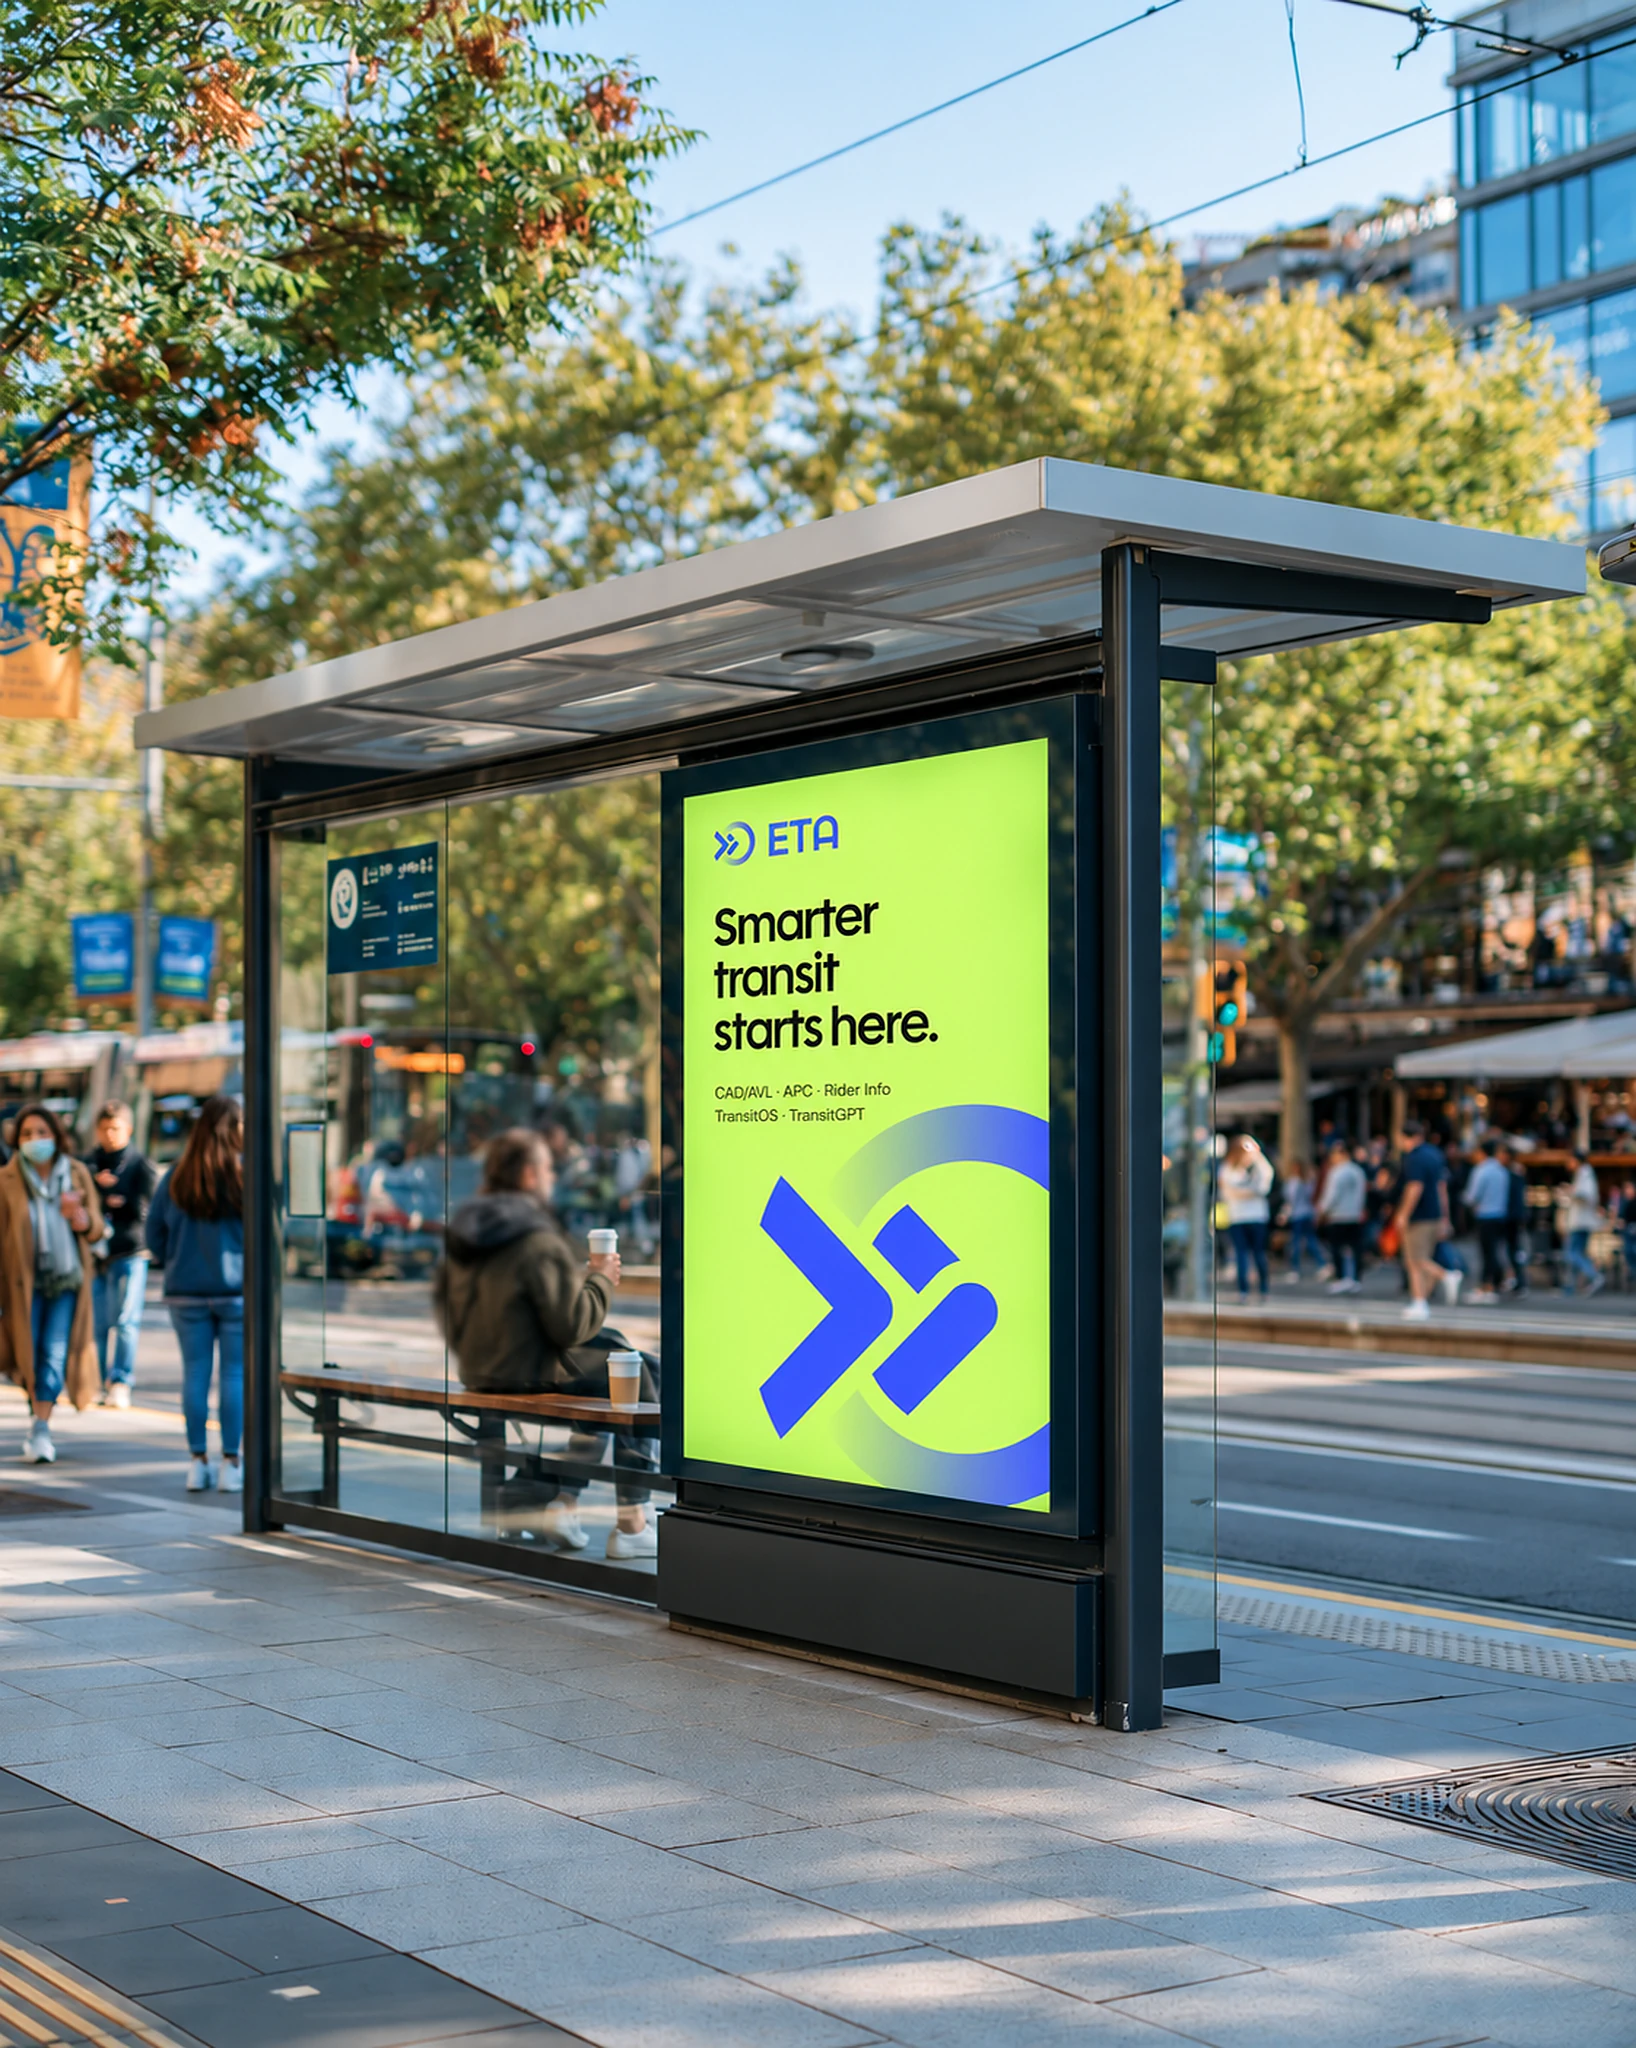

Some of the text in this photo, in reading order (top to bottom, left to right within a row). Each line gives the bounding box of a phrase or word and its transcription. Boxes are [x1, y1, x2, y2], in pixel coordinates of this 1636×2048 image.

[768, 814, 839, 857] ETA
[714, 898, 879, 946] Smarter
[714, 950, 840, 999] transit
[714, 1004, 939, 1052] starts here.
[714, 1082, 892, 1101] CAD/AVL APC Rider Info
[714, 1106, 866, 1123] TransitOS TransitGPT
